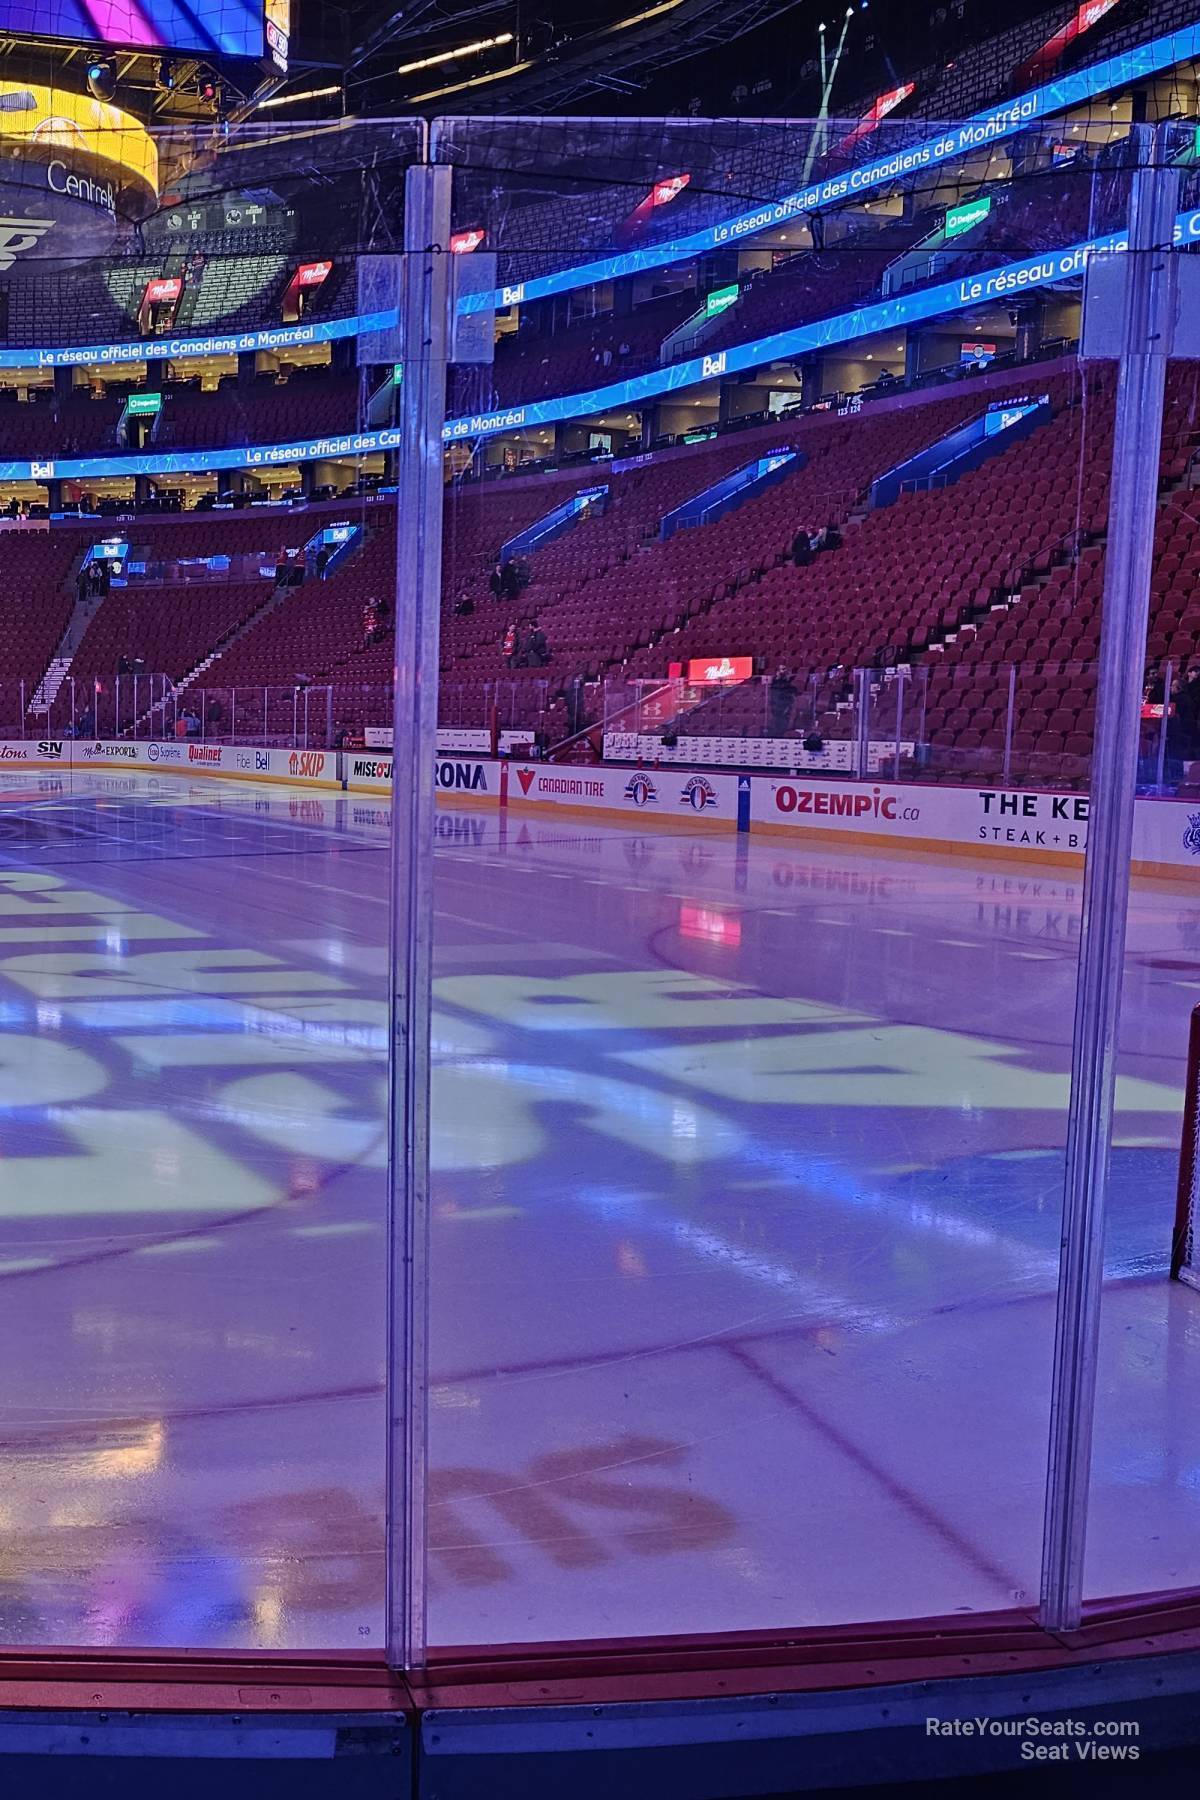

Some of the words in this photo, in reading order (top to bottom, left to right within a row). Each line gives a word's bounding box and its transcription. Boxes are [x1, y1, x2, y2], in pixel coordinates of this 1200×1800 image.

[713, 226, 728, 242] Le
[730, 210, 772, 238] réseau
[774, 187, 819, 220] officiel
[822, 182, 847, 201] des
[850, 149, 930, 188] Canadiens
[935, 133, 955, 157] de
[959, 95, 1038, 149] Montréal
[191, 219, 198, 230] 6
[252, 214, 257, 225] 1
[960, 281, 981, 302] Le
[986, 261, 1054, 295] réseau
[502, 284, 524, 305] Bell
[39, 350, 54, 363] Le
[57, 348, 98, 363] réseau
[101, 343, 143, 359] officiel
[146, 343, 168, 356] des
[171, 338, 237, 354] Canadiens
[240, 335, 256, 348] de
[258, 327, 314, 345] Montréal
[703, 352, 726, 377] Bell
[837, 407, 849, 417] 123
[850, 405, 862, 414] 124
[246, 448, 262, 464] Le
[265, 445, 307, 461] réseau
[309, 437, 352, 457] officiel
[353, 434, 376, 449] des
[453, 421, 469, 435] de
[471, 409, 525, 432] Montréal
[31, 461, 54, 478] Bell
[37, 741, 64, 754] SN
[188, 744, 223, 762] Qualinet
[255, 751, 270, 771] Bell
[299, 751, 325, 778] SKIP
[538, 777, 583, 797] CANADIAN
[585, 781, 605, 797] TIRE
[979, 791, 1038, 817] THE
[1052, 797, 1089, 821] KE
[979, 826, 1046, 845] STEAK
